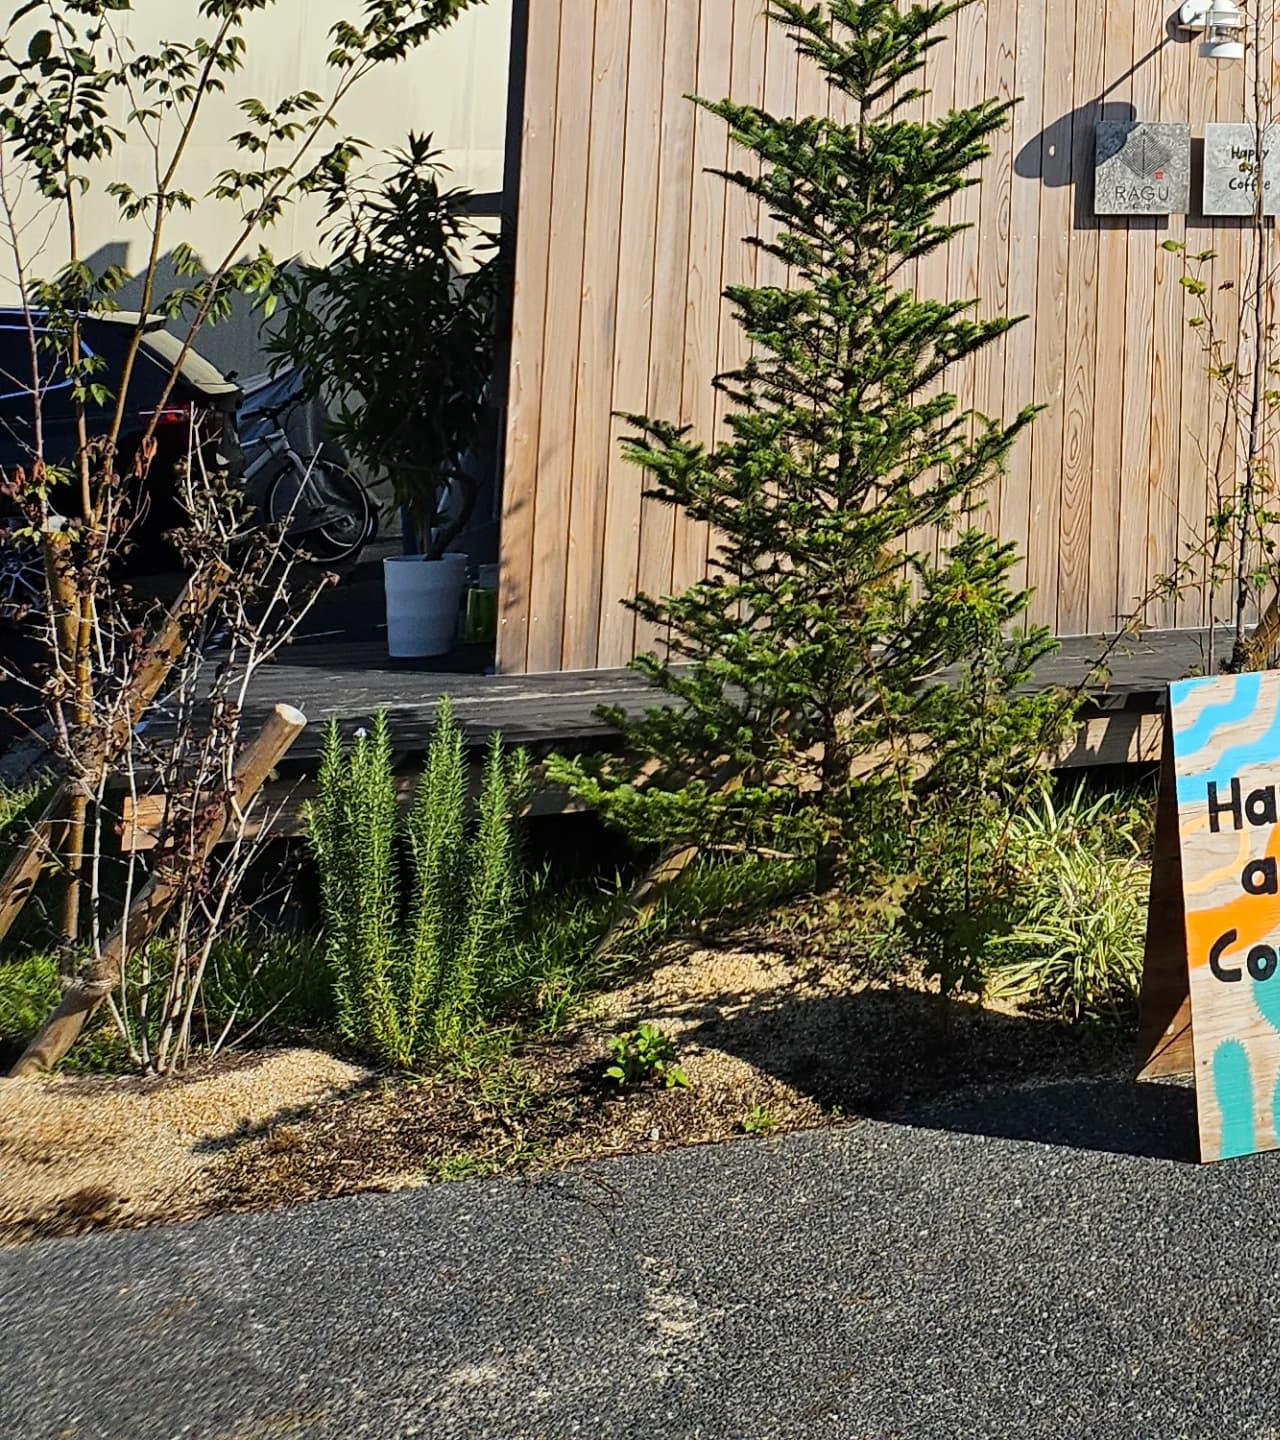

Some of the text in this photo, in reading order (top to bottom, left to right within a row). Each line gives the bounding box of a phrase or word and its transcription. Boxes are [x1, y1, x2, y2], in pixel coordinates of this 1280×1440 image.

[1231, 146, 1269, 162] Hapy
[1228, 177, 1271, 192] Coffe
[1115, 185, 1169, 203] RAGU
